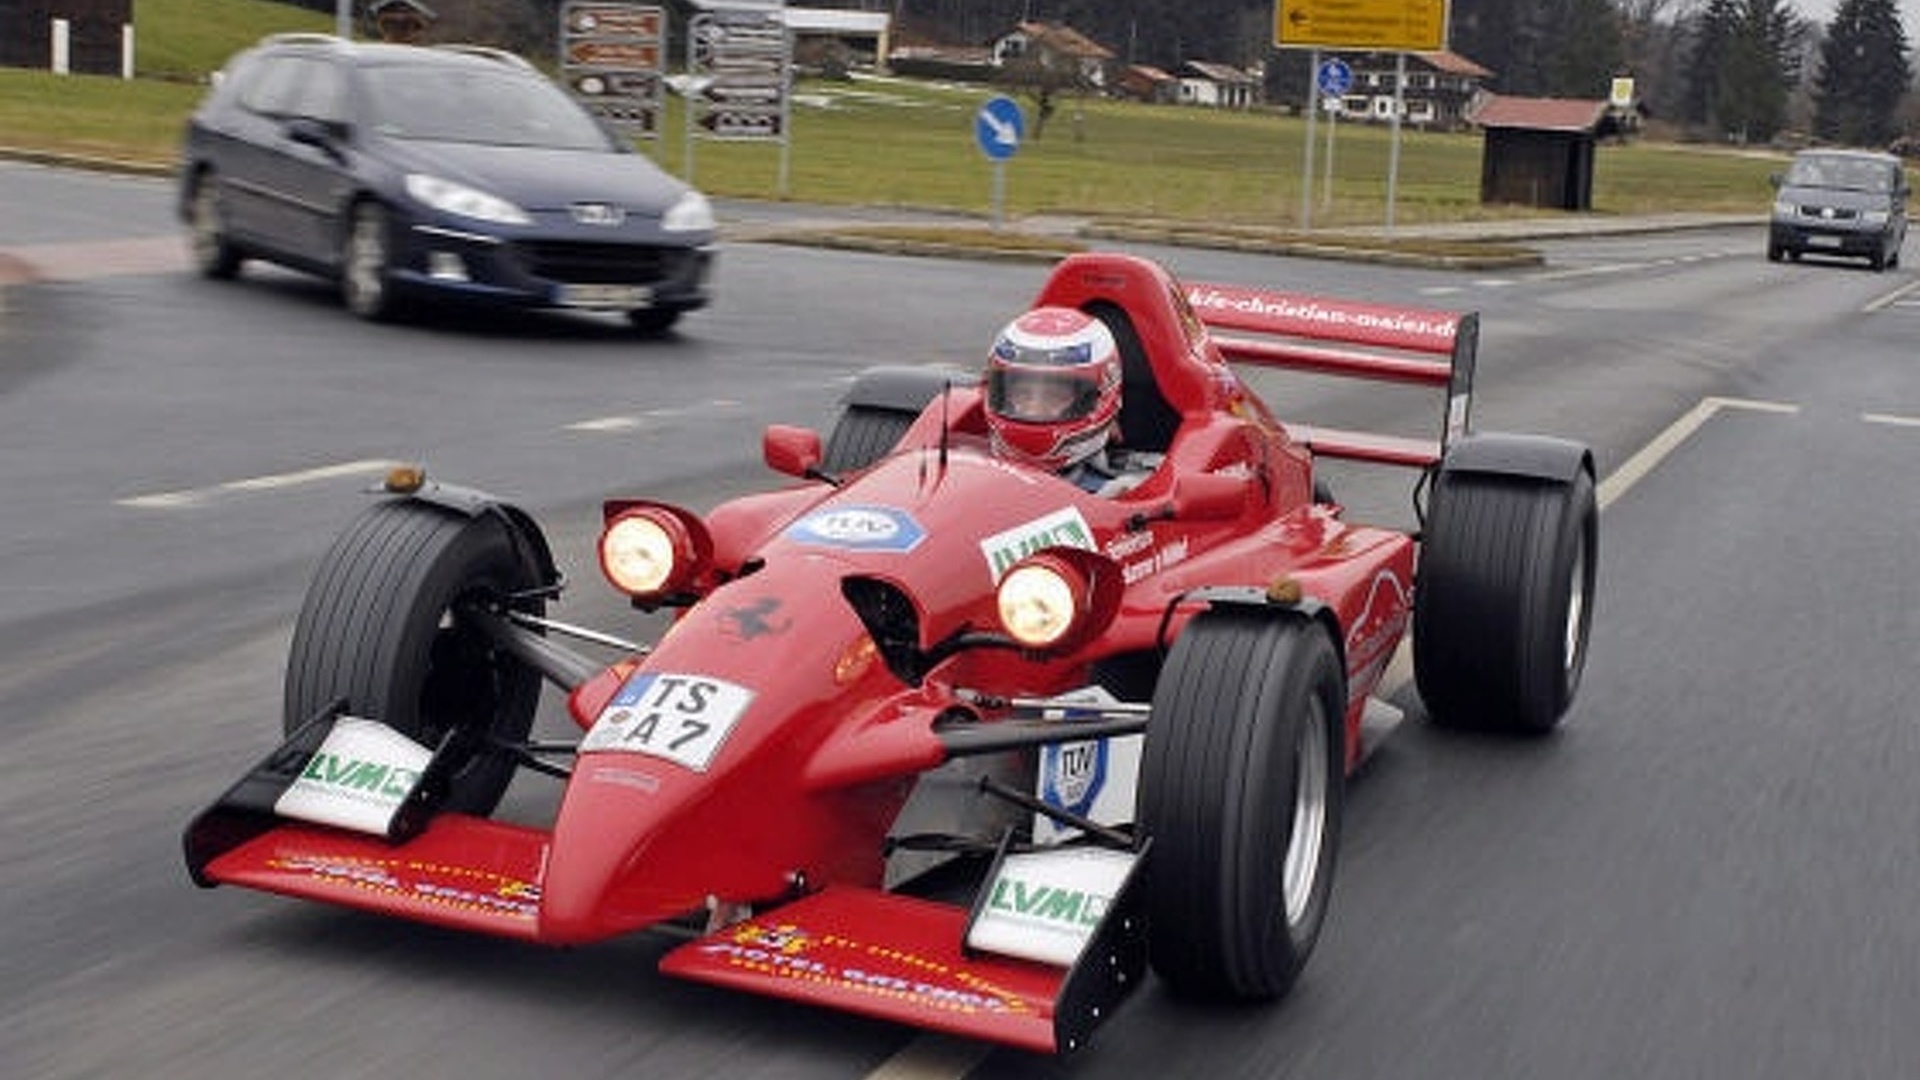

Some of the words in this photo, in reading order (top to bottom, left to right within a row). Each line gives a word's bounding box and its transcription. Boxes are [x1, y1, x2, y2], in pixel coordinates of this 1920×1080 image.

[652, 678, 719, 714] TS
[624, 712, 662, 745] A
[667, 719, 711, 751] 7
[301, 753, 389, 792] LVM
[991, 879, 1085, 922] LVM
